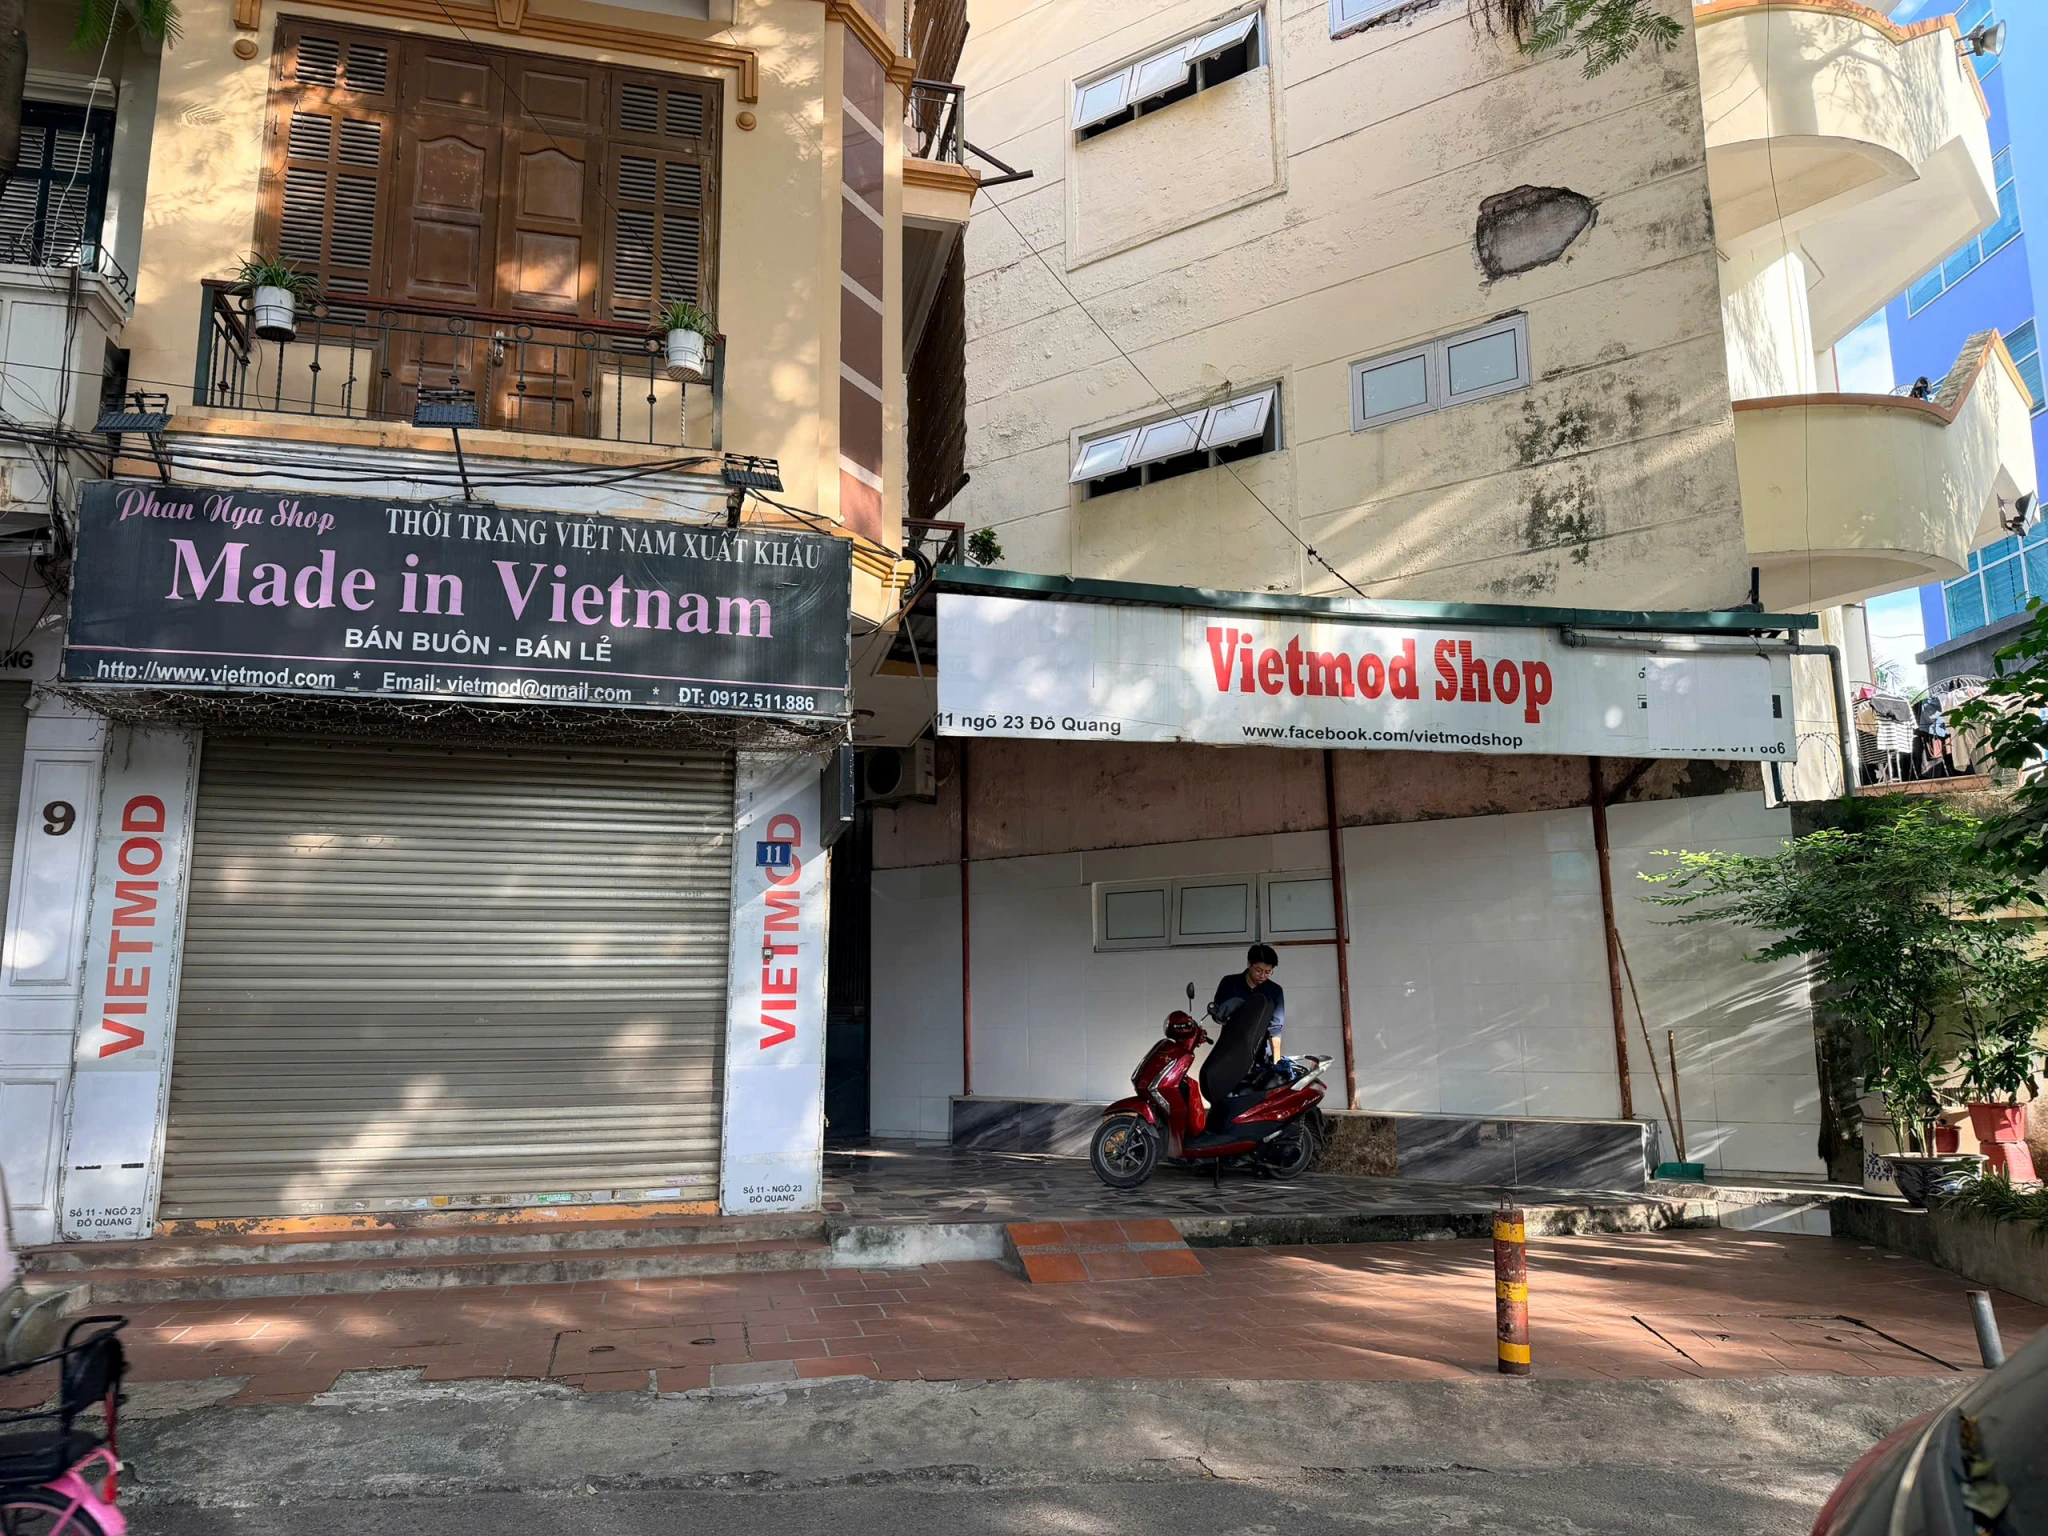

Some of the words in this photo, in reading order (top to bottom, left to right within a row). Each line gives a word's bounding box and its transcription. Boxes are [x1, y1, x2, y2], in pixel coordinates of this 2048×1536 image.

[115, 488, 195, 521] Phan
[203, 494, 264, 529] Nga
[270, 499, 336, 535] Shop
[386, 503, 452, 538] THỜI
[458, 513, 547, 545] TRANG
[555, 517, 614, 555] VIỆT
[620, 526, 676, 556] NAM
[165, 538, 376, 611] Made
[399, 554, 464, 616] in
[492, 560, 773, 638] Vietnam
[345, 625, 402, 650] BÁN
[412, 629, 490, 655] BUÔN
[515, 635, 570, 661] BÁN
[580, 635, 612, 662] LẺ
[97, 660, 335, 688] http://www.vietmod.com
[383, 671, 440, 691] Email:
[678, 687, 705, 704] ĐT:
[709, 690, 815, 711] 0912.511.886
[1206, 626, 1420, 701] Vietmod
[1434, 638, 1553, 724] Shop
[961, 714, 997, 731] ngõ
[1003, 715, 1024, 729] 23
[1062, 717, 1121, 736] Quang
[1242, 725, 1523, 749] www.facebook.com/vietmodshop
[42, 800, 77, 837] 9
[765, 845, 782, 864] 11
[98, 794, 167, 1059] VIETMOD
[130, 1207, 142, 1215] 23
[764, 1194, 795, 1203] QUANG
[94, 1218, 132, 1227] QUANG
